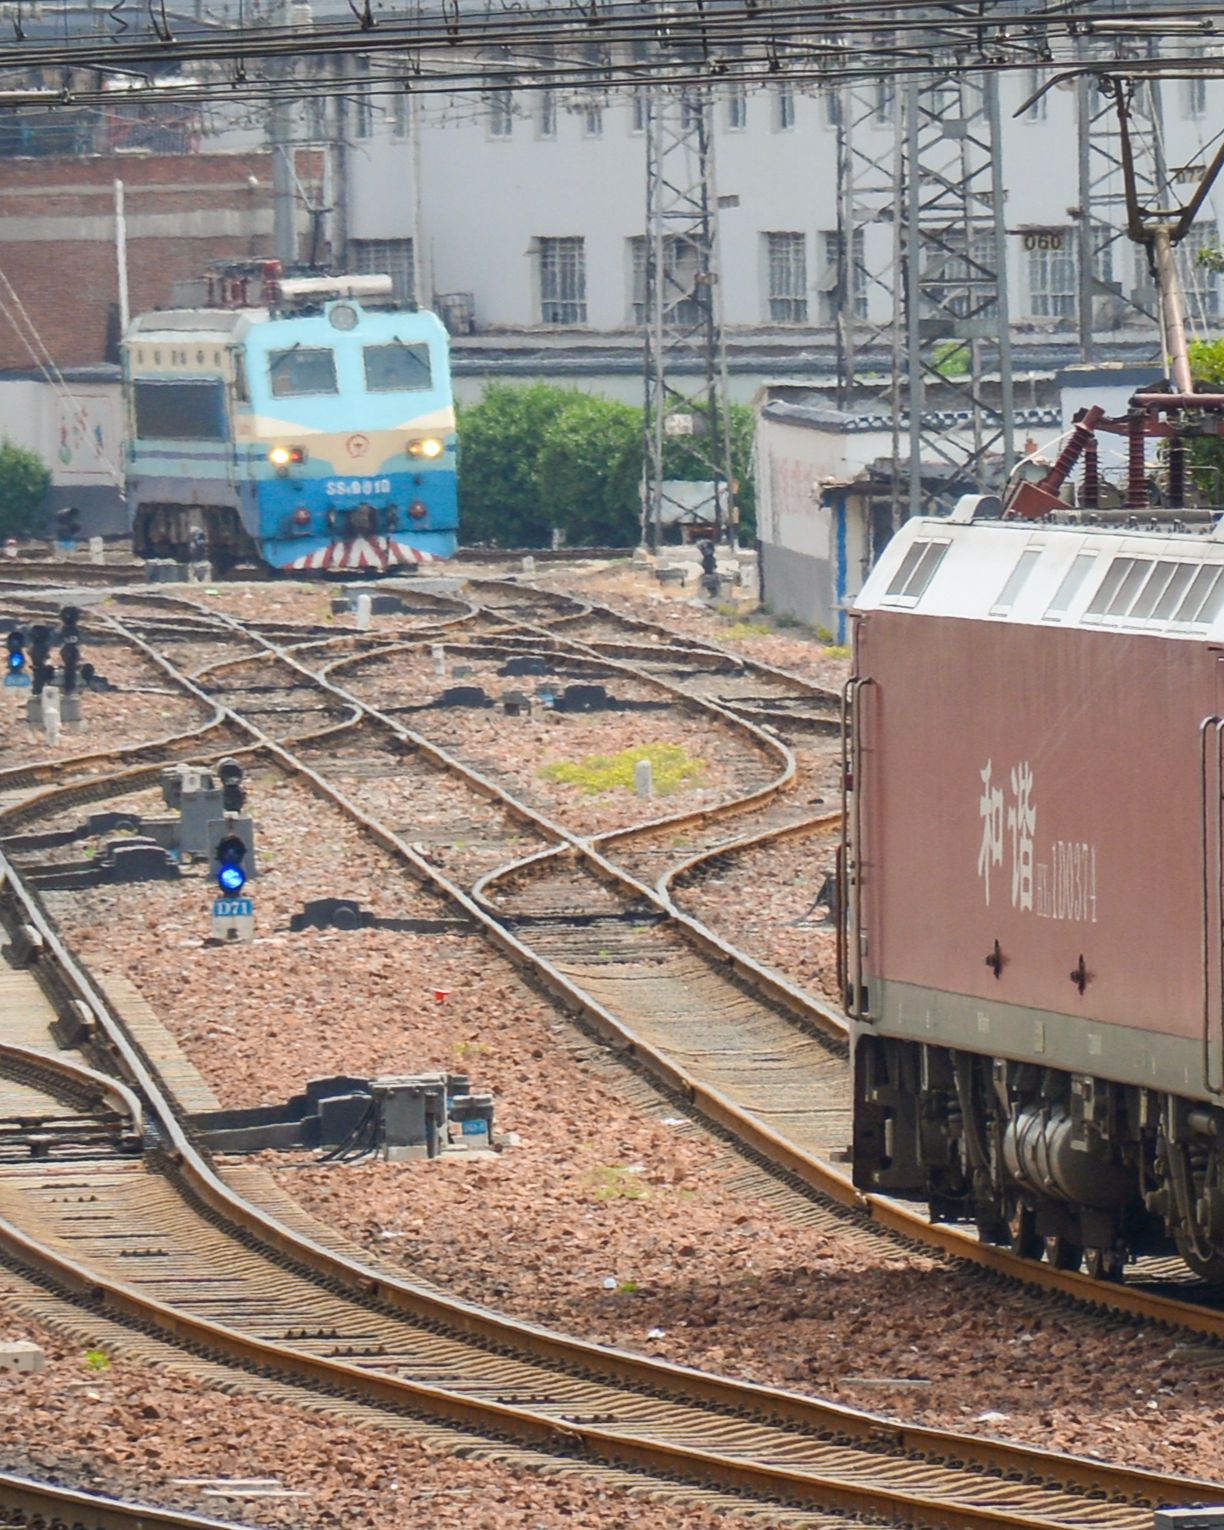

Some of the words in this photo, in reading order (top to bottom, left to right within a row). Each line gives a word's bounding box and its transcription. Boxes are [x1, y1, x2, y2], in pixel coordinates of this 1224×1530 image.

[1024, 234, 1062, 250] 060
[977, 757, 1036, 912] 和谐
[217, 901, 249, 915] D71
